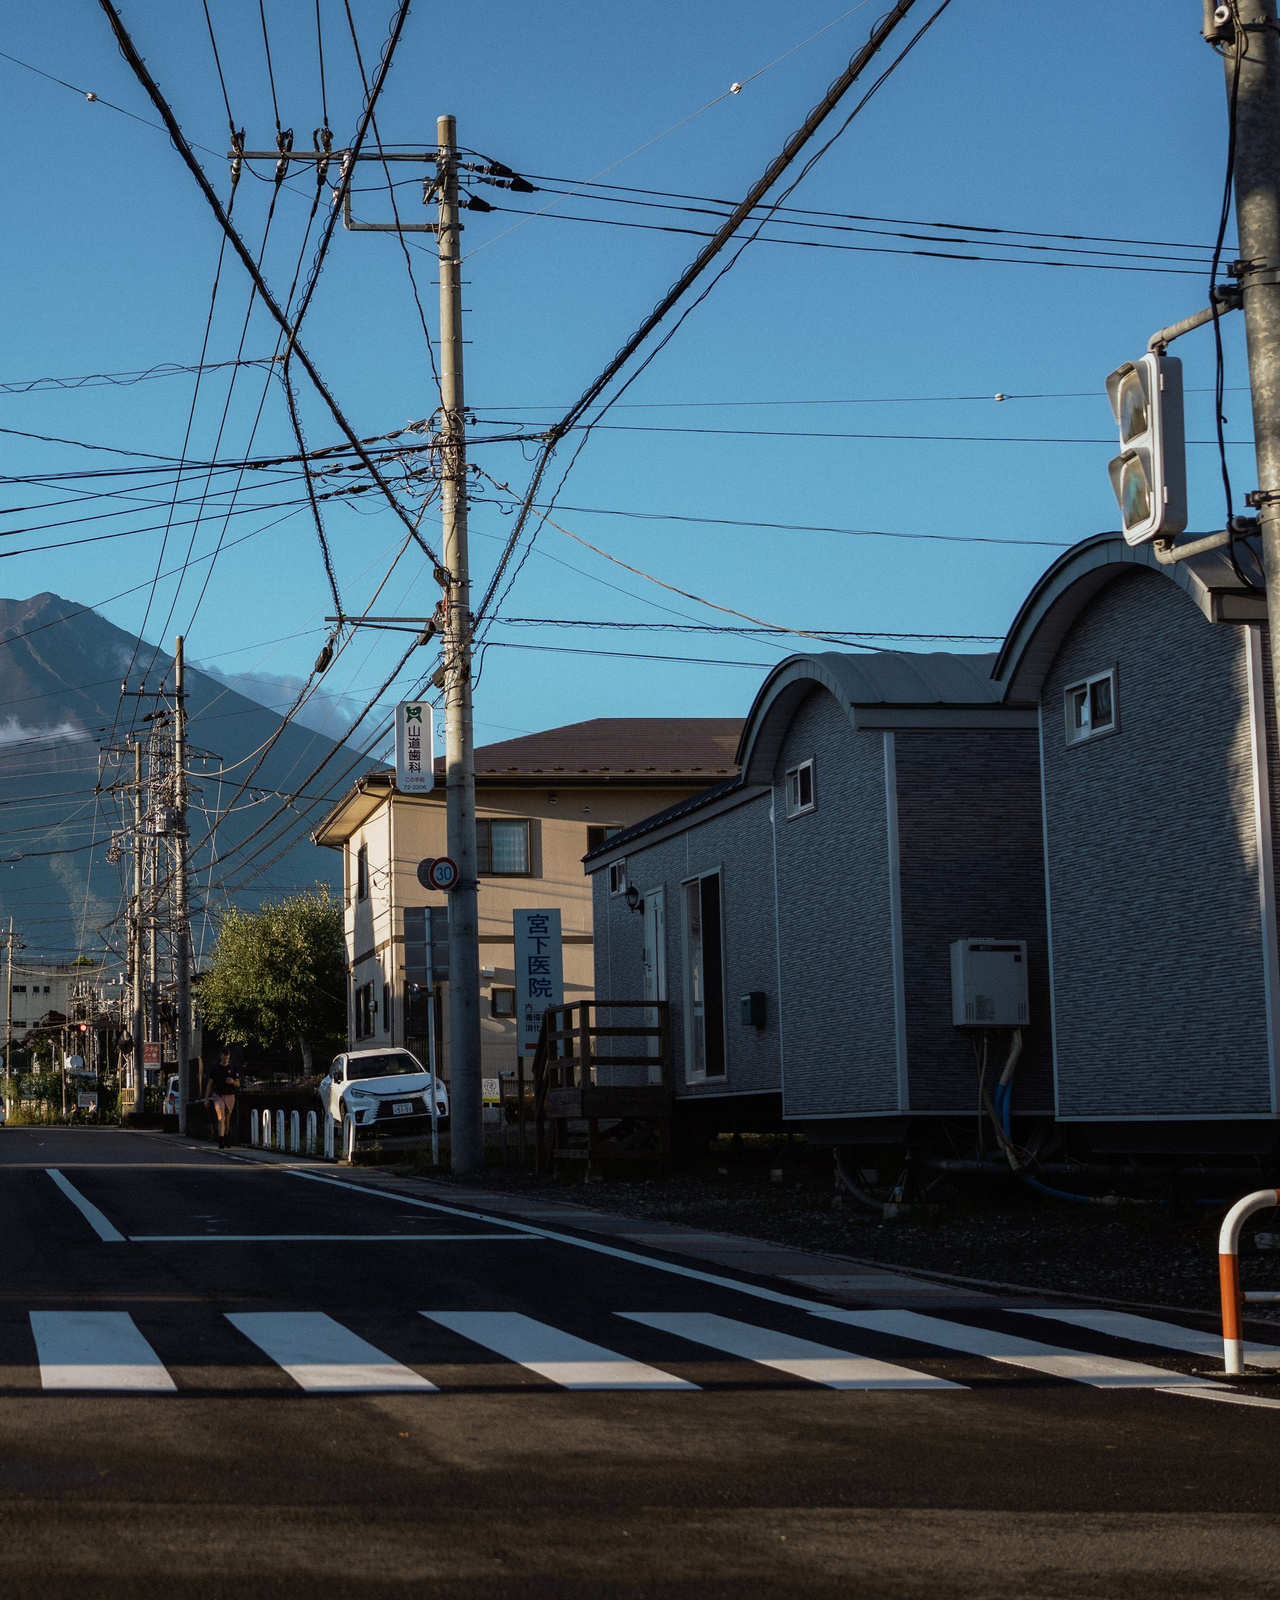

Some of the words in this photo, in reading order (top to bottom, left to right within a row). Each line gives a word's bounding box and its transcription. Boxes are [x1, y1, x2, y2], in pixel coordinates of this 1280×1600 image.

[408, 725, 422, 774] 山道歯科
[436, 866, 452, 881] 30
[526, 913, 553, 998] 宮下医院
[524, 1013, 545, 1022] 循環
